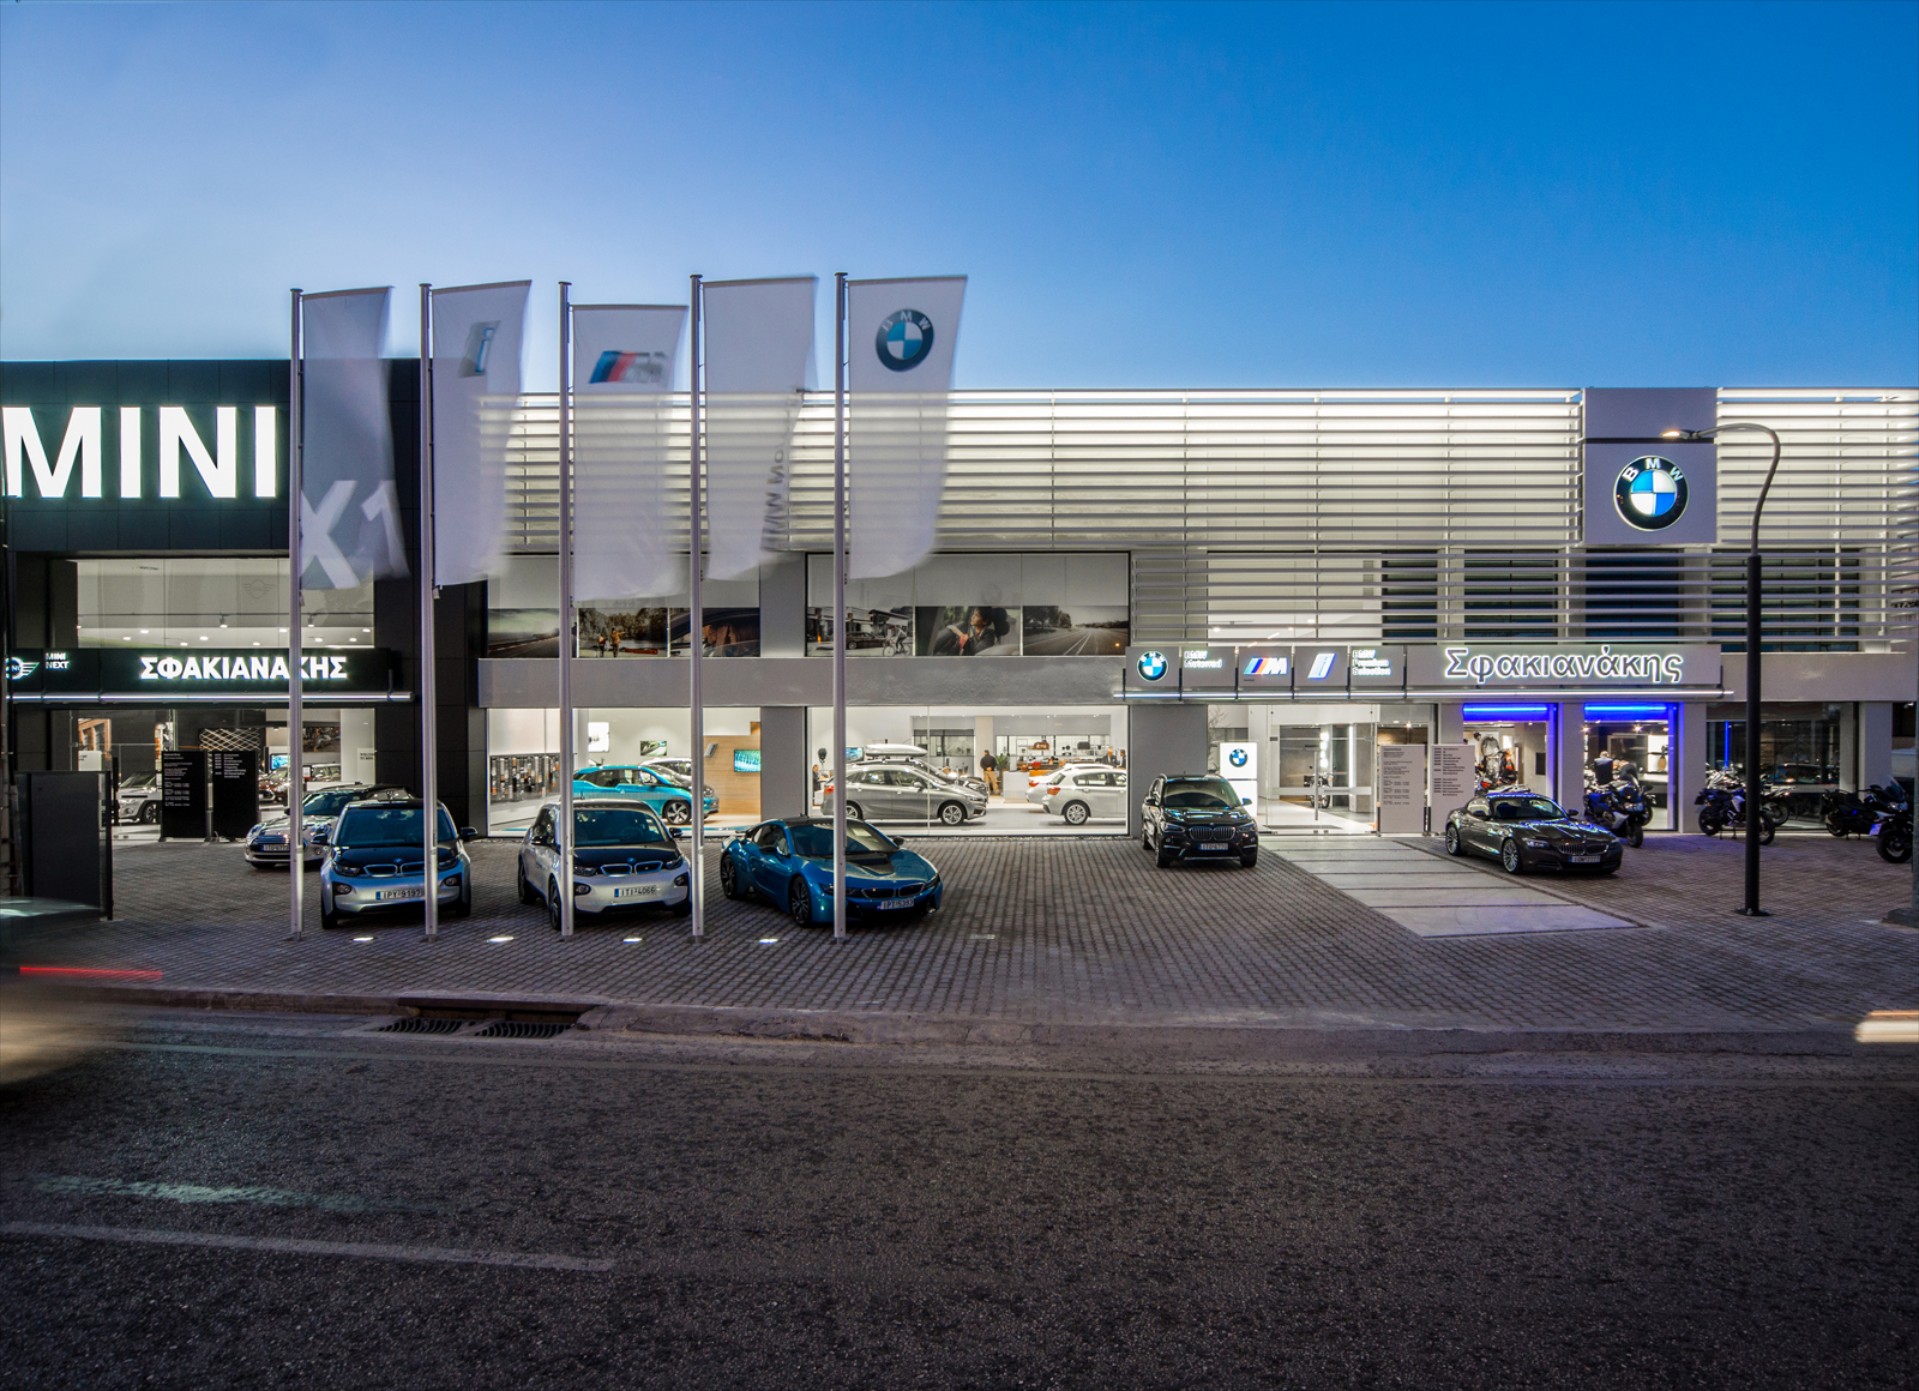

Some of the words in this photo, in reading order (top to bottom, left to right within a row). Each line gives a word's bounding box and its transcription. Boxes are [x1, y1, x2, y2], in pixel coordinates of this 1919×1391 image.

[2, 406, 277, 498] MINI
[1622, 457, 1684, 482] BMW
[1445, 645, 1684, 683] Σφακιανάκης
